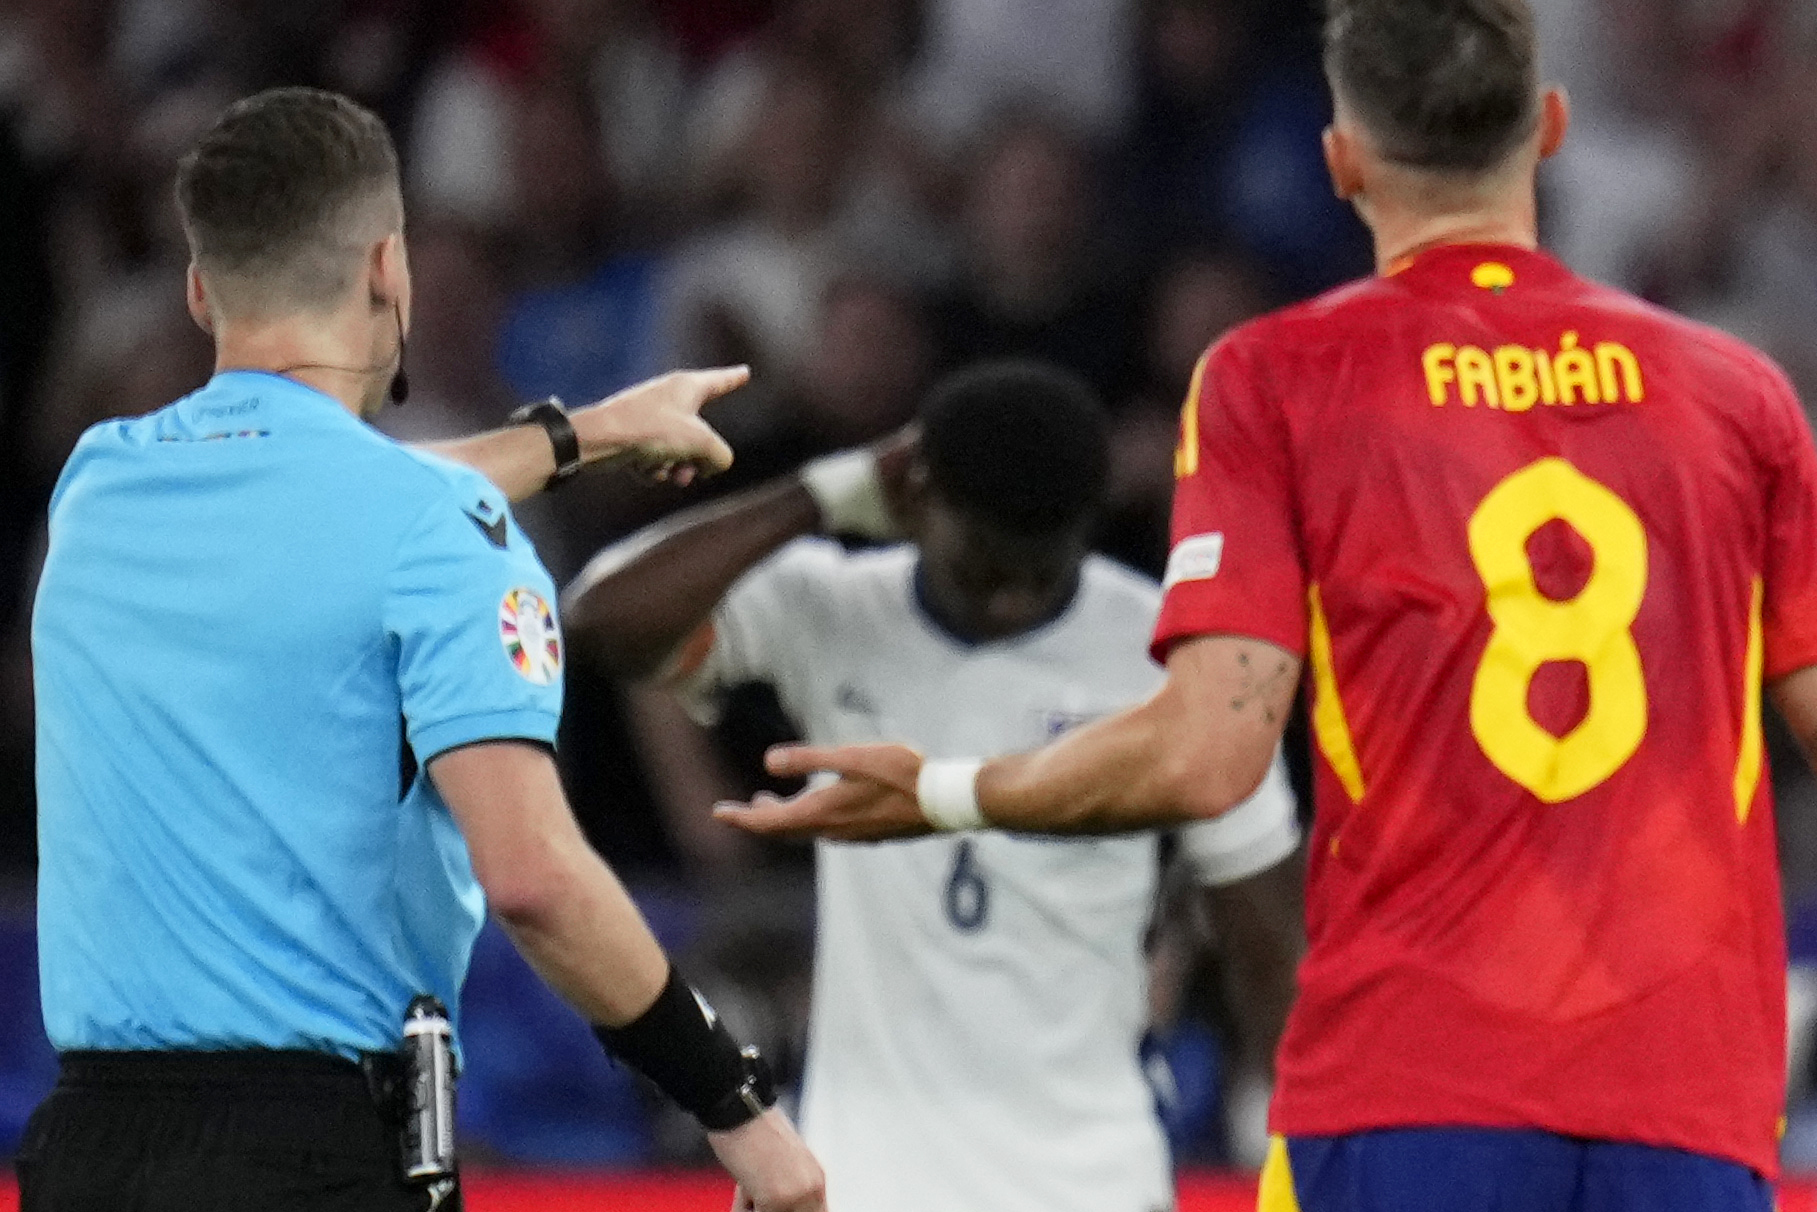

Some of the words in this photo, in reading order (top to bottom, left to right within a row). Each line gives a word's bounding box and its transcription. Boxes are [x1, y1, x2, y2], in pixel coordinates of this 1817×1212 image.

[1422, 330, 1645, 412] FABIÁN
[1468, 456, 1650, 804] 8
[943, 836, 990, 935] 6
